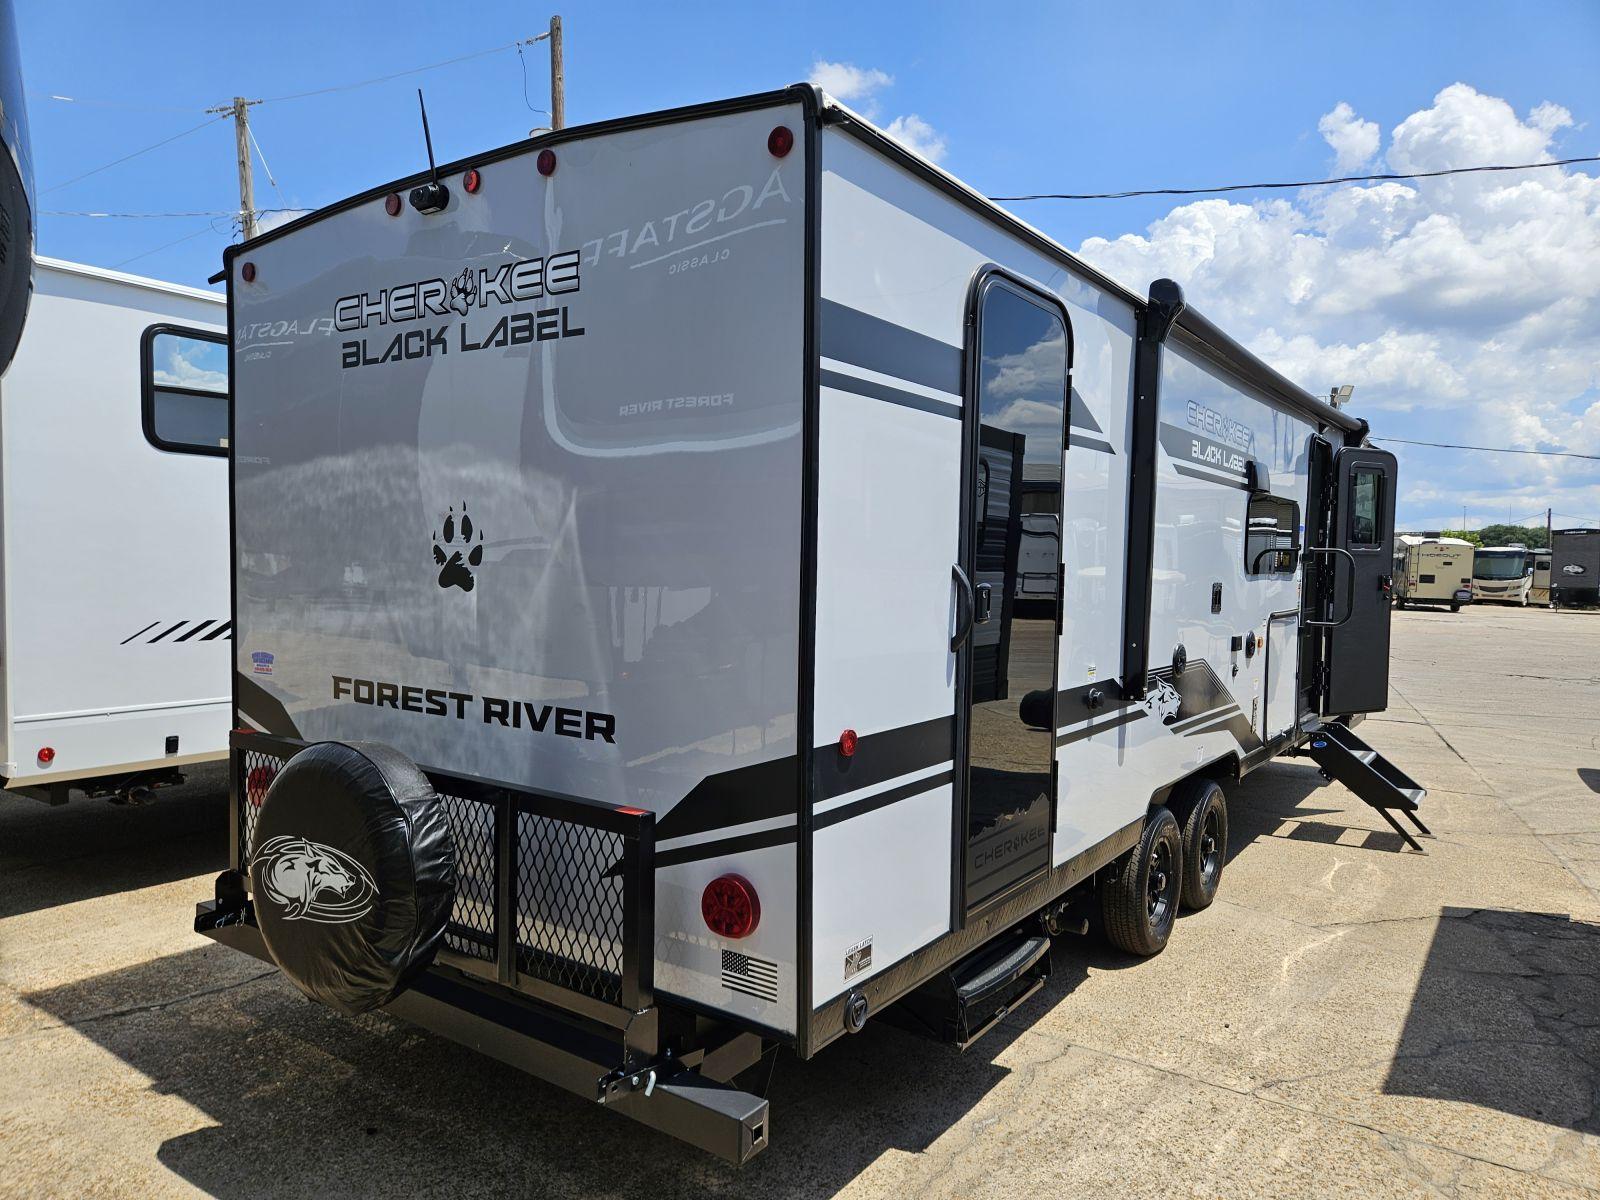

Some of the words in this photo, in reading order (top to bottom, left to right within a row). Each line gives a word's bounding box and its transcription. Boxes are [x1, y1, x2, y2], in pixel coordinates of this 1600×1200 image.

[342, 326, 448, 369] BLACK
[461, 307, 585, 352] LABEL
[1192, 440, 1221, 465] BLACK
[1224, 450, 1247, 473] LABEL
[332, 675, 473, 720] FOREST
[482, 696, 616, 744] RIVER
